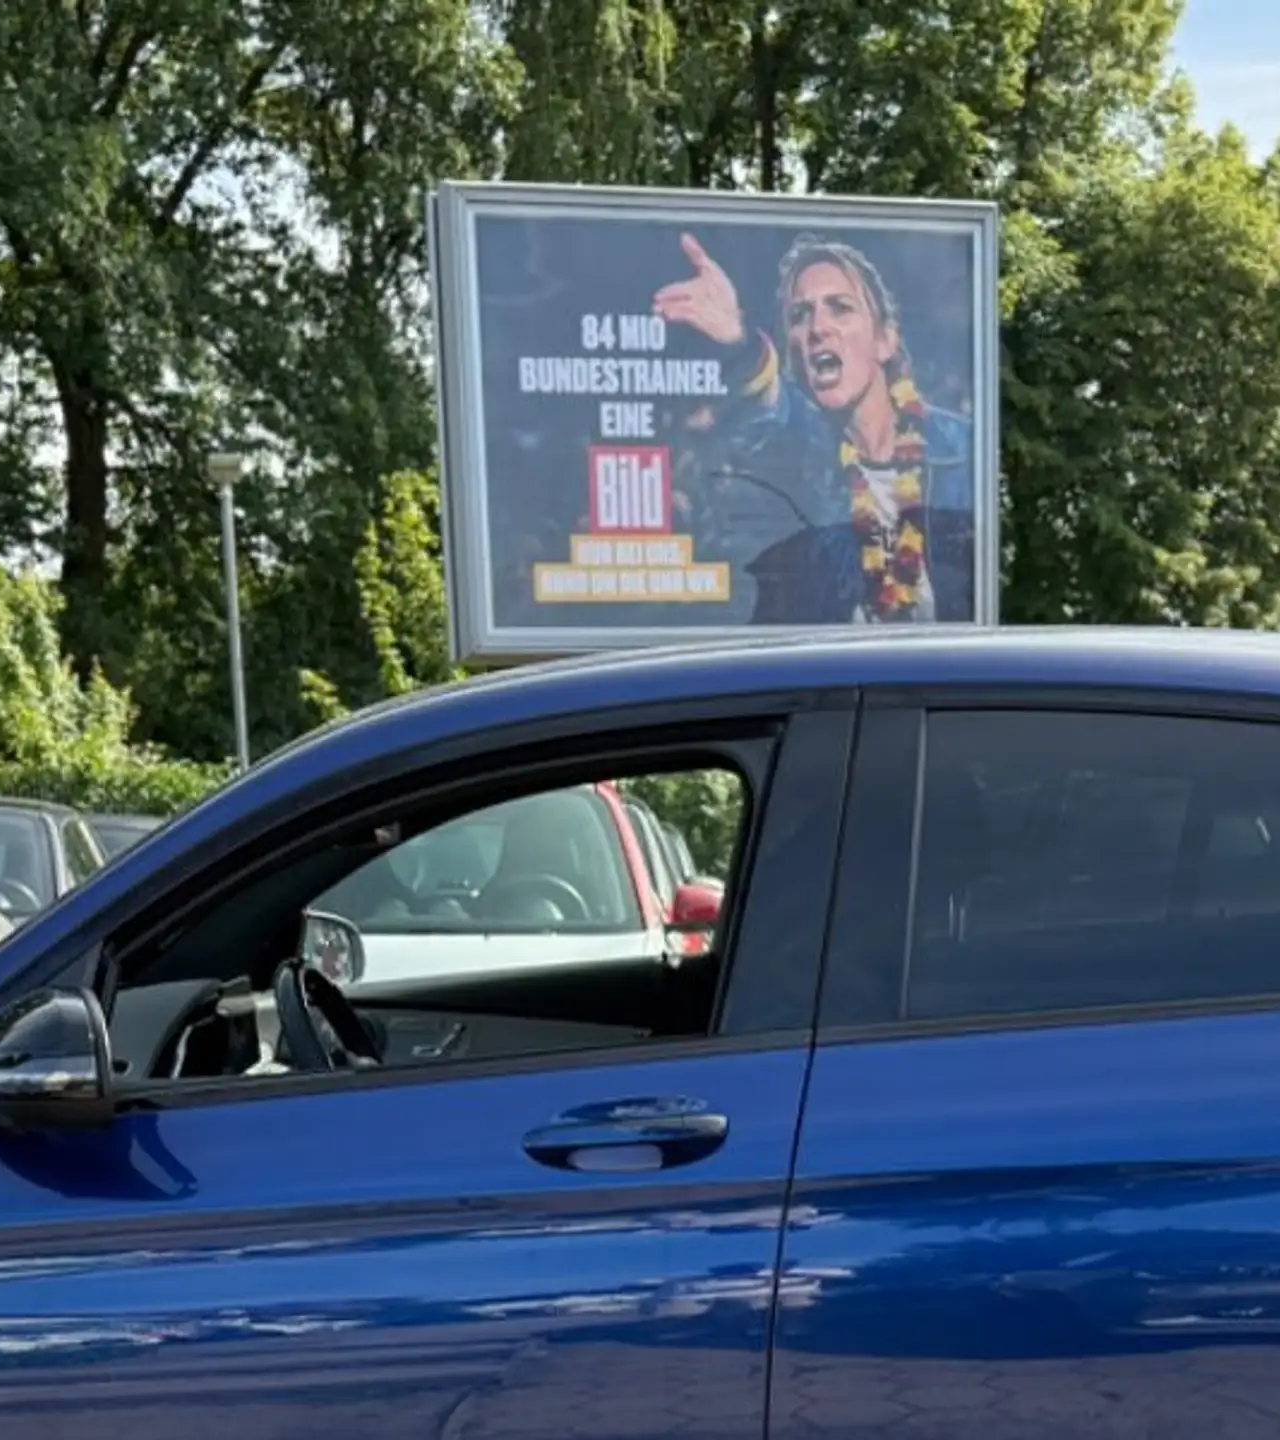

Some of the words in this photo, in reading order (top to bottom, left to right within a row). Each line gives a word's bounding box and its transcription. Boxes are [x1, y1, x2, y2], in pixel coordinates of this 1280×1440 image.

[581, 313, 616, 350] 84
[619, 313, 666, 350] MIO
[519, 356, 728, 395] BUNDESTRAINER.
[599, 401, 656, 437] EINE
